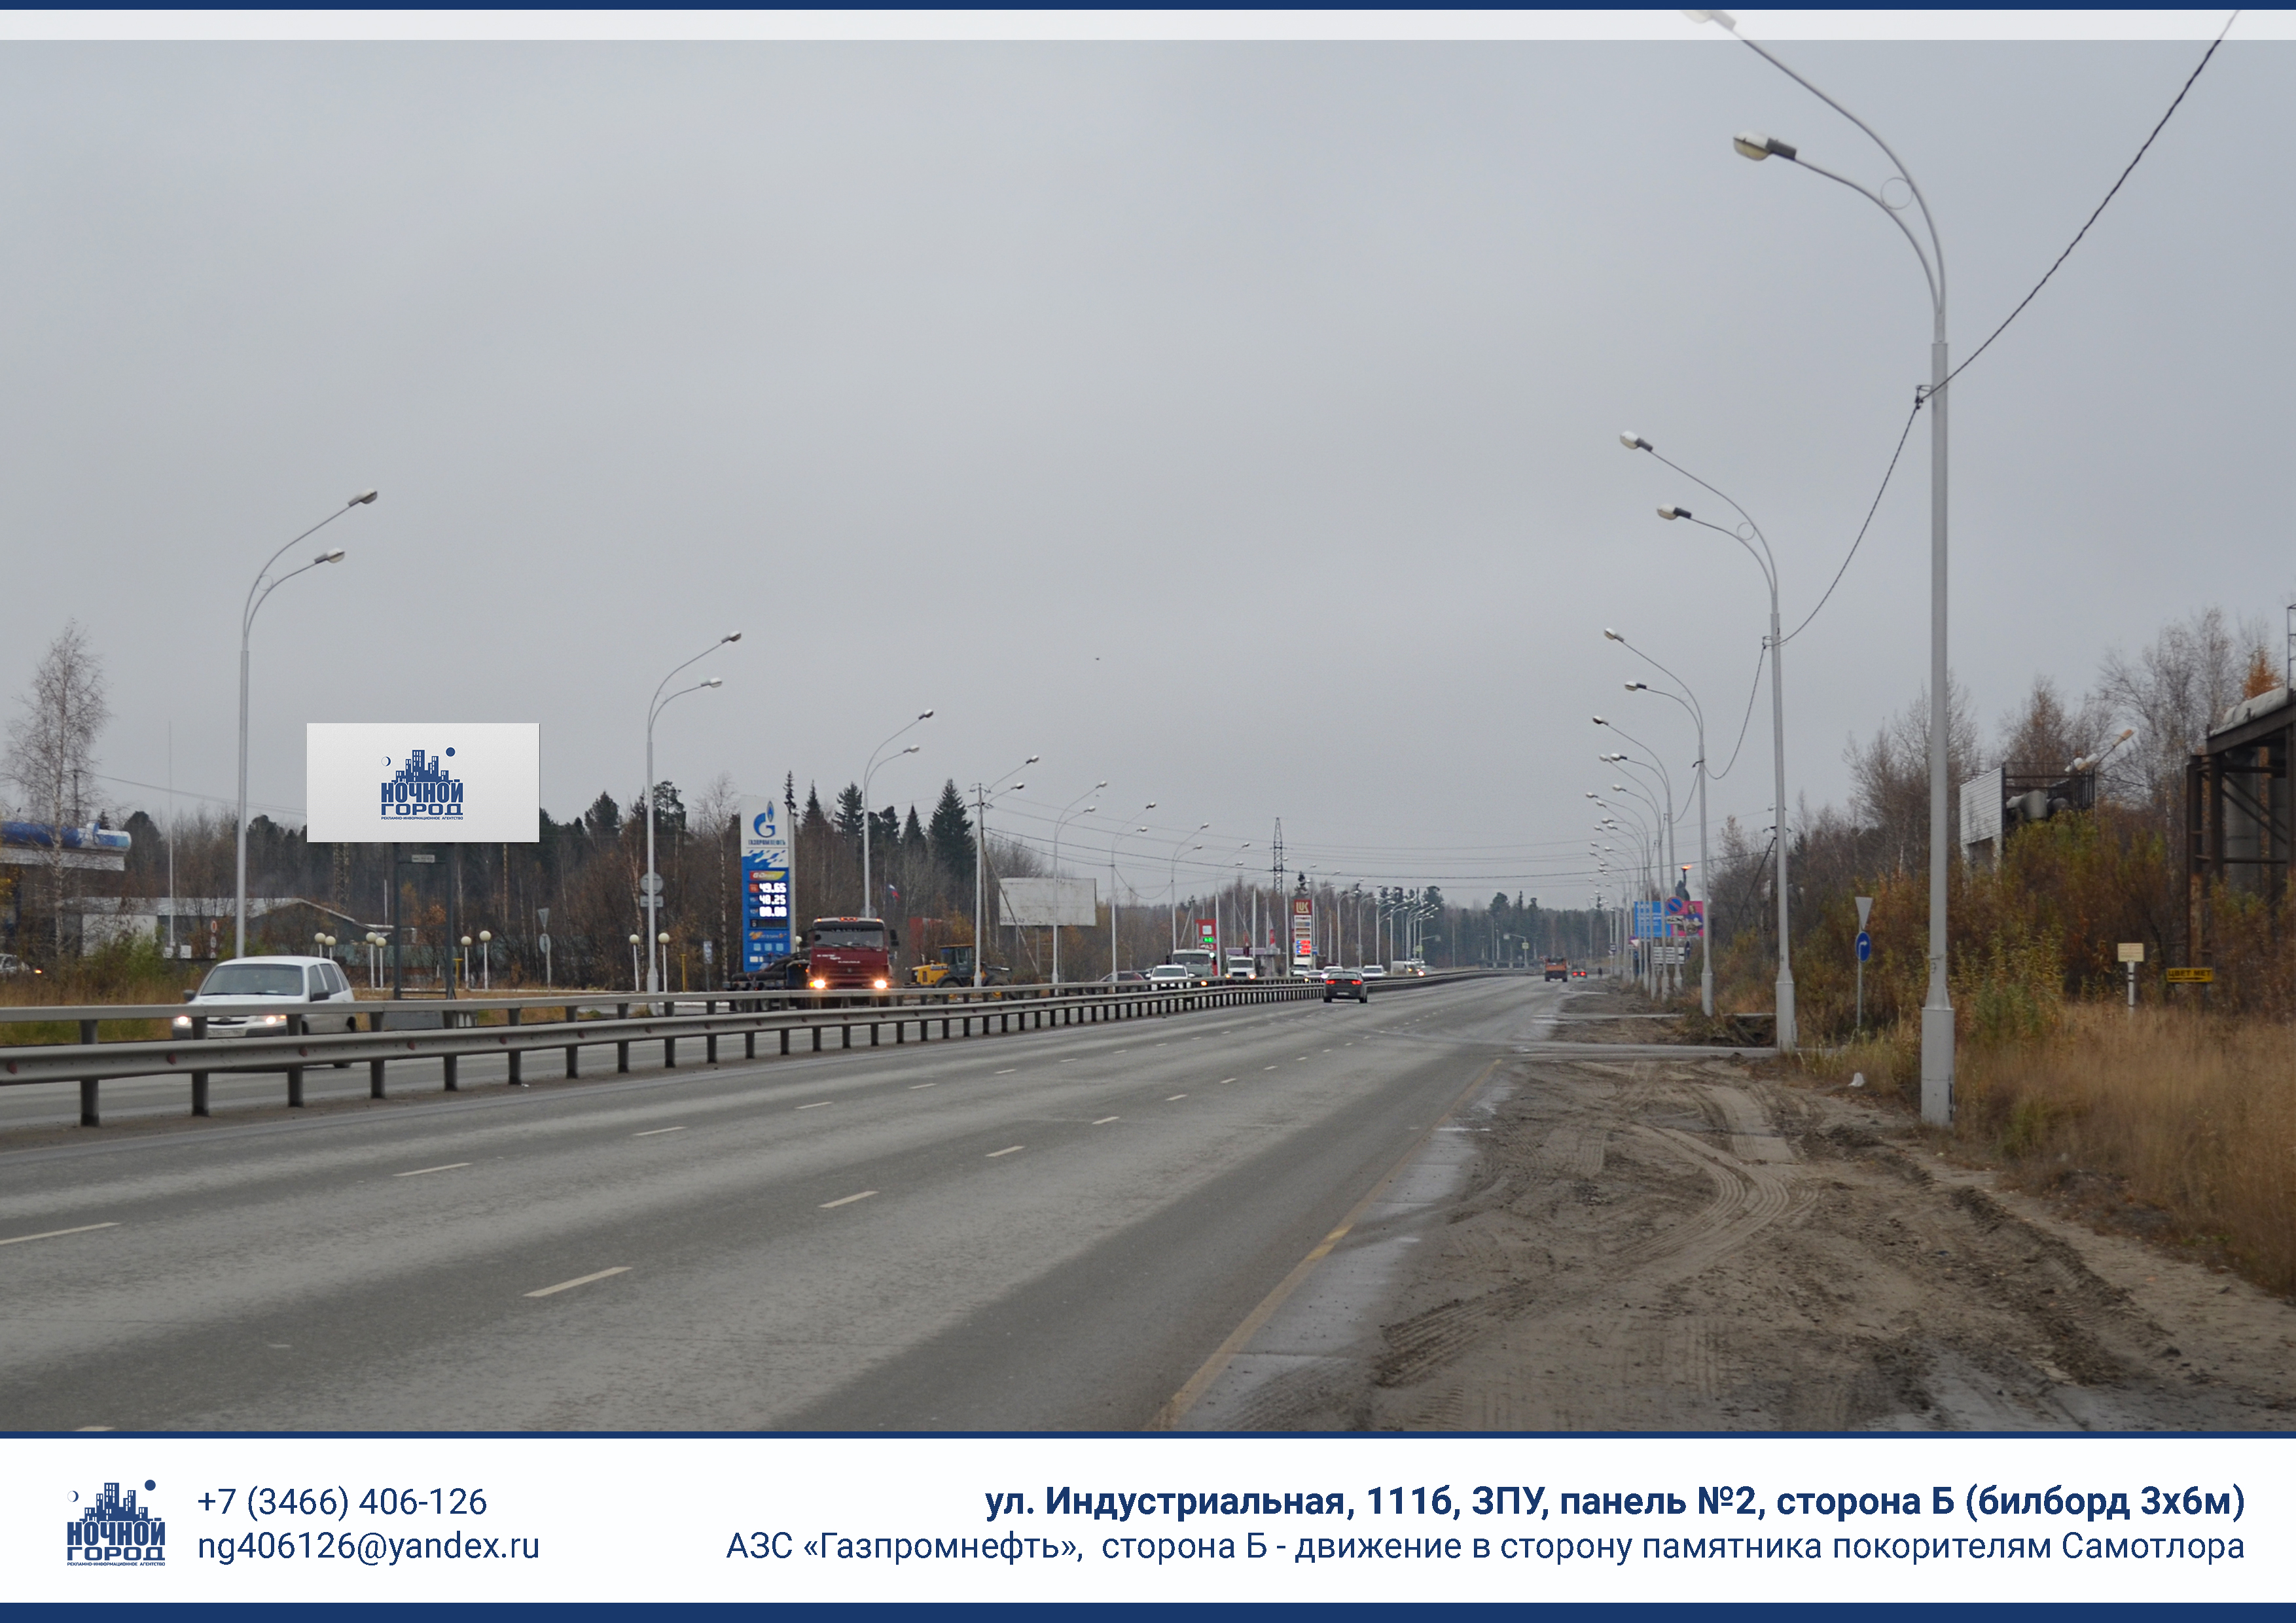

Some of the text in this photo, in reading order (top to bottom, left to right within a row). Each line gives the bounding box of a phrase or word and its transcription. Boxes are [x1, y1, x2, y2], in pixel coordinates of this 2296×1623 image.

[381, 779, 463, 803] НОЧНОЙ
[381, 804, 463, 815] ГОРОД
[759, 894, 786, 904] 48.25
